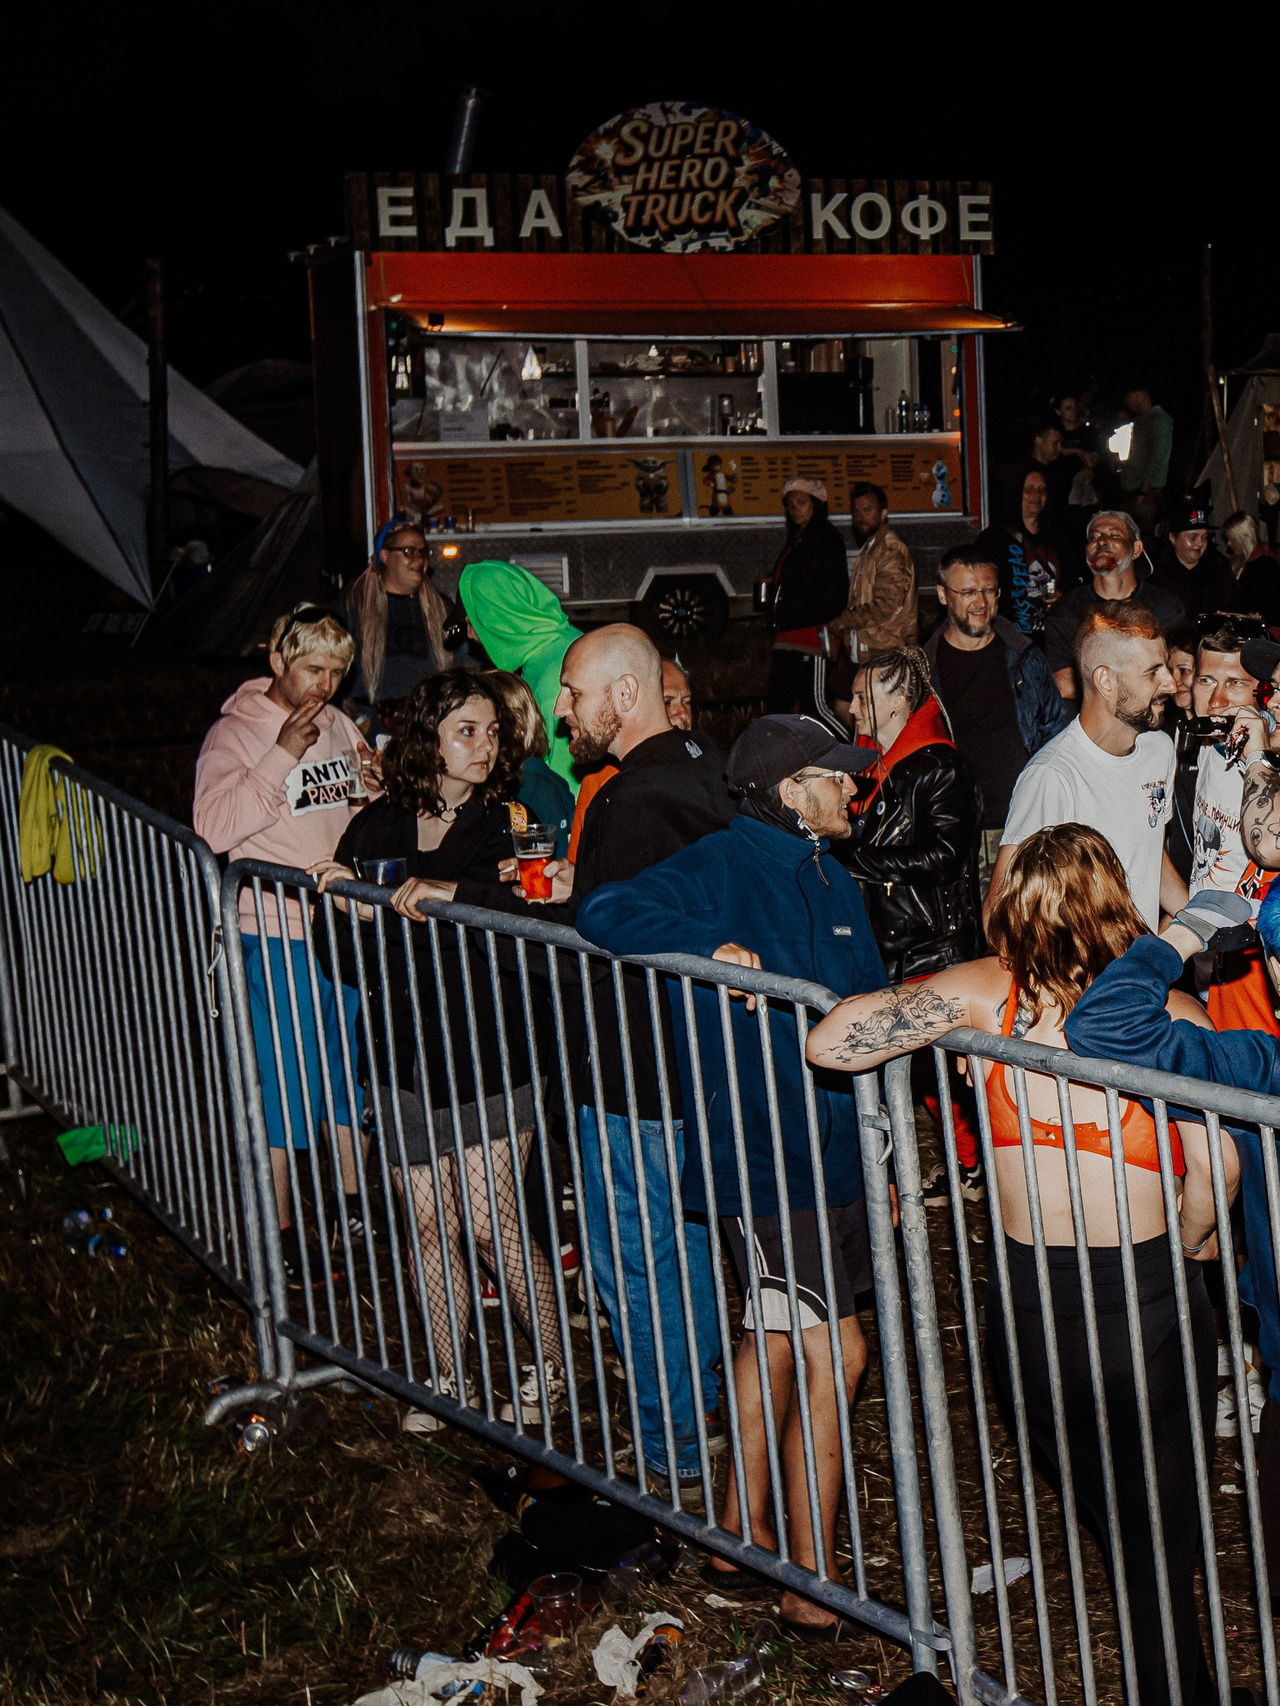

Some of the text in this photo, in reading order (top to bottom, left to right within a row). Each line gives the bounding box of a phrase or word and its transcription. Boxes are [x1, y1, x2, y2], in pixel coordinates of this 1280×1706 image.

[612, 119, 739, 167] SUPER
[633, 156, 729, 191] HERO
[376, 186, 563, 248] ЕДА
[621, 186, 743, 233] TRUCK
[811, 192, 994, 241] КОФЕ
[301, 760, 349, 787] ANTI
[305, 780, 350, 806] PARTY
